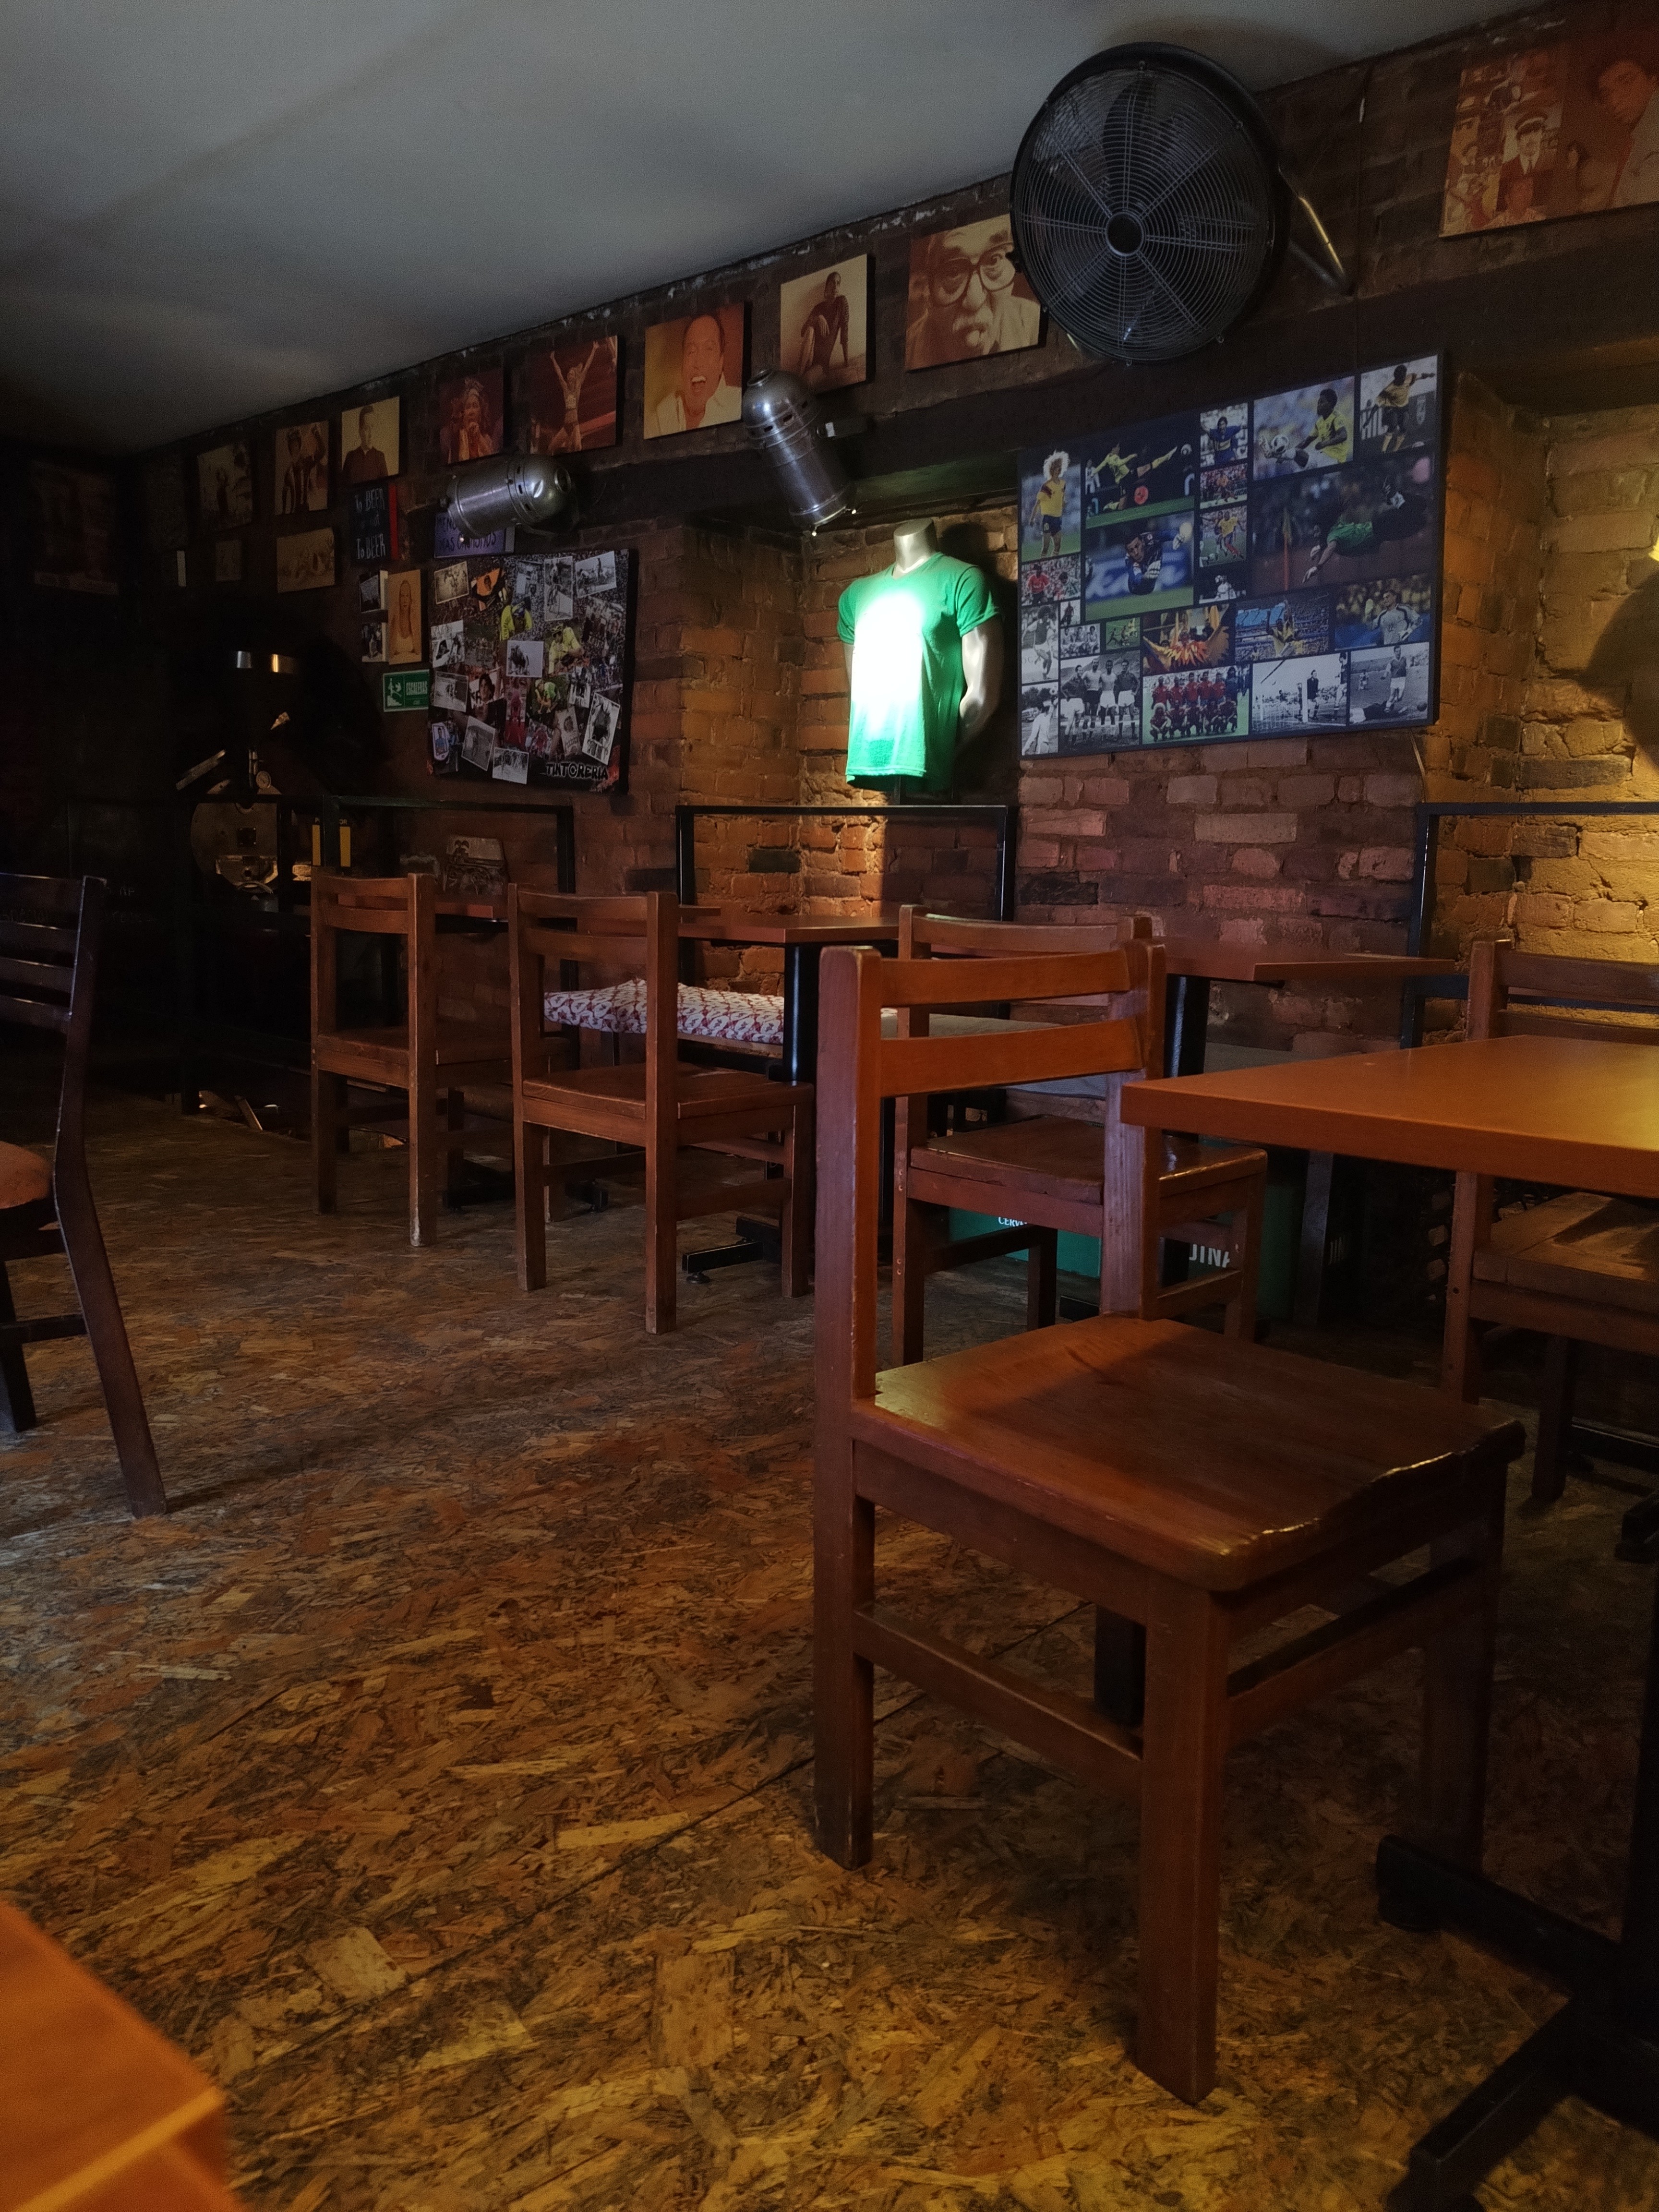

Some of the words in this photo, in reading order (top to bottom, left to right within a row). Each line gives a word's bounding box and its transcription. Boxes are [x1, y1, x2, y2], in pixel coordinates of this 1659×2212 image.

[365, 488, 385, 511] BEER
[366, 532, 386, 560] BEER
[546, 762, 609, 781] TINTORERIA
